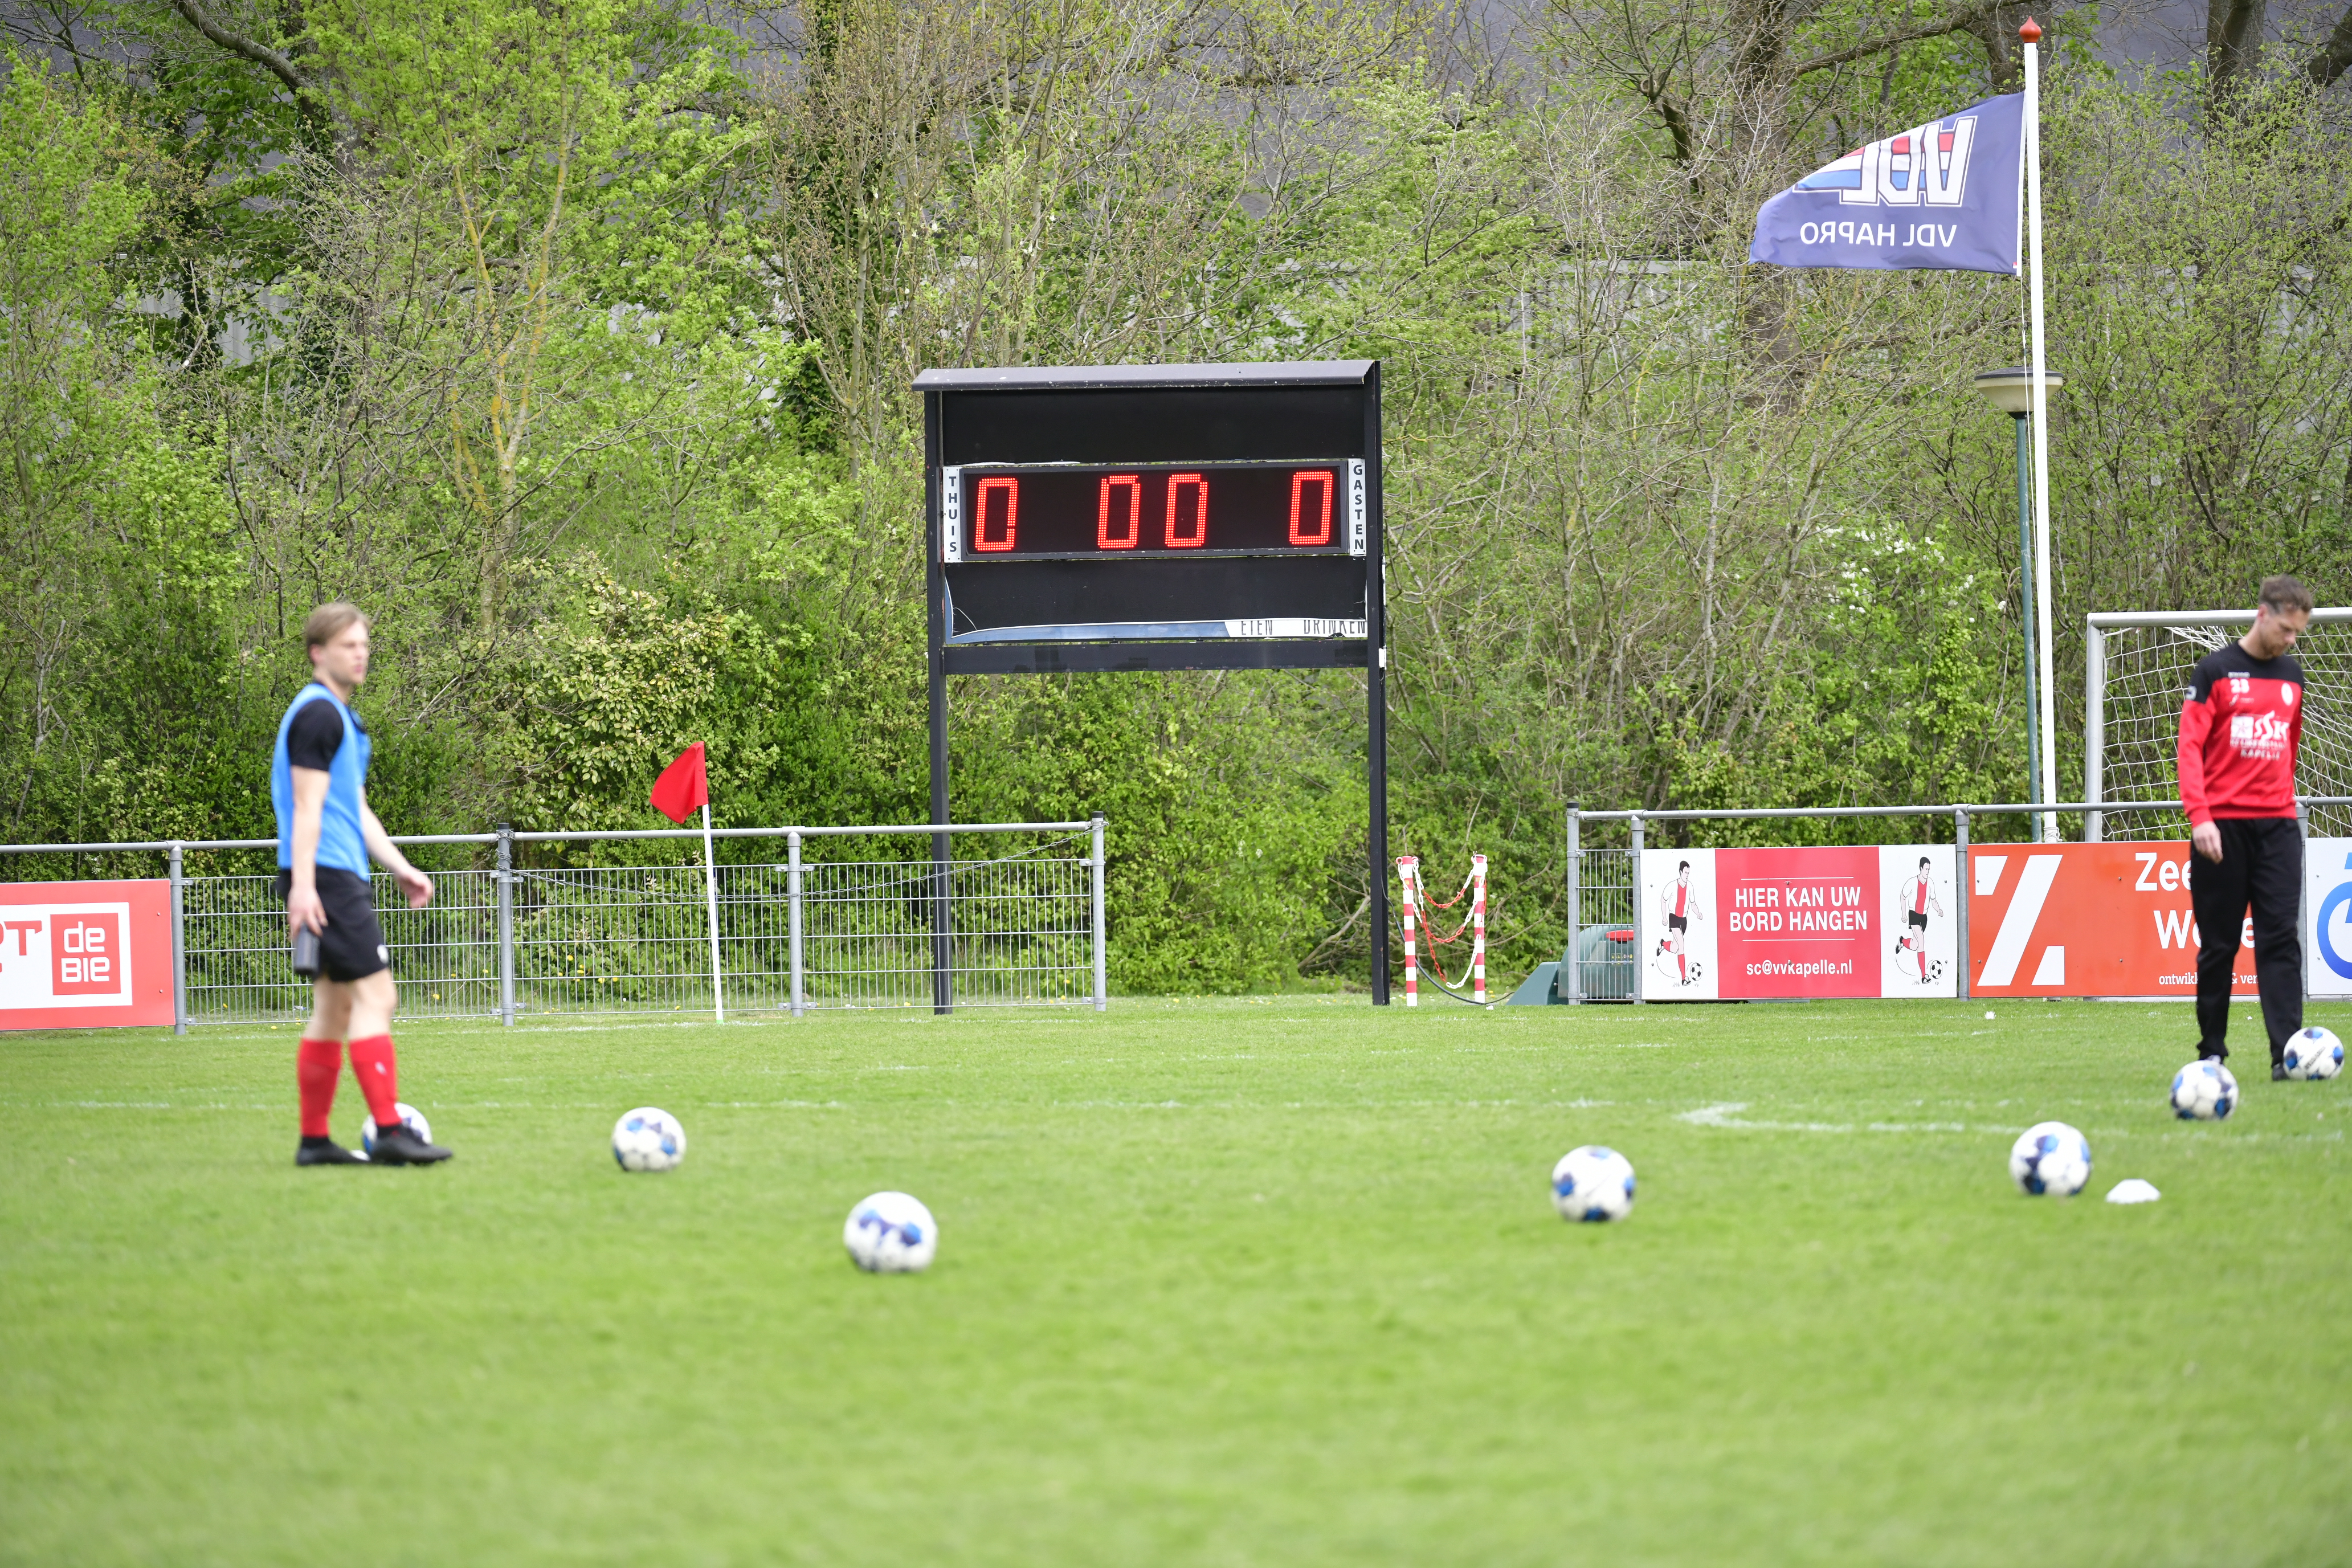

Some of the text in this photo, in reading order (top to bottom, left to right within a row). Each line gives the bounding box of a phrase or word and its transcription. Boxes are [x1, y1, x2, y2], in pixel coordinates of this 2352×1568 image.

[948, 476, 957, 553] THUIS
[975, 477, 1018, 551] 0
[1289, 471, 1333, 545] 0
[1353, 464, 1364, 550] GASTEN
[1736, 887, 1861, 908] HIER KAN UW
[64, 921, 106, 953] de
[1730, 910, 1867, 932] BORD HANGEN
[1746, 959, 1852, 978] sc@vvkapelle.nl
